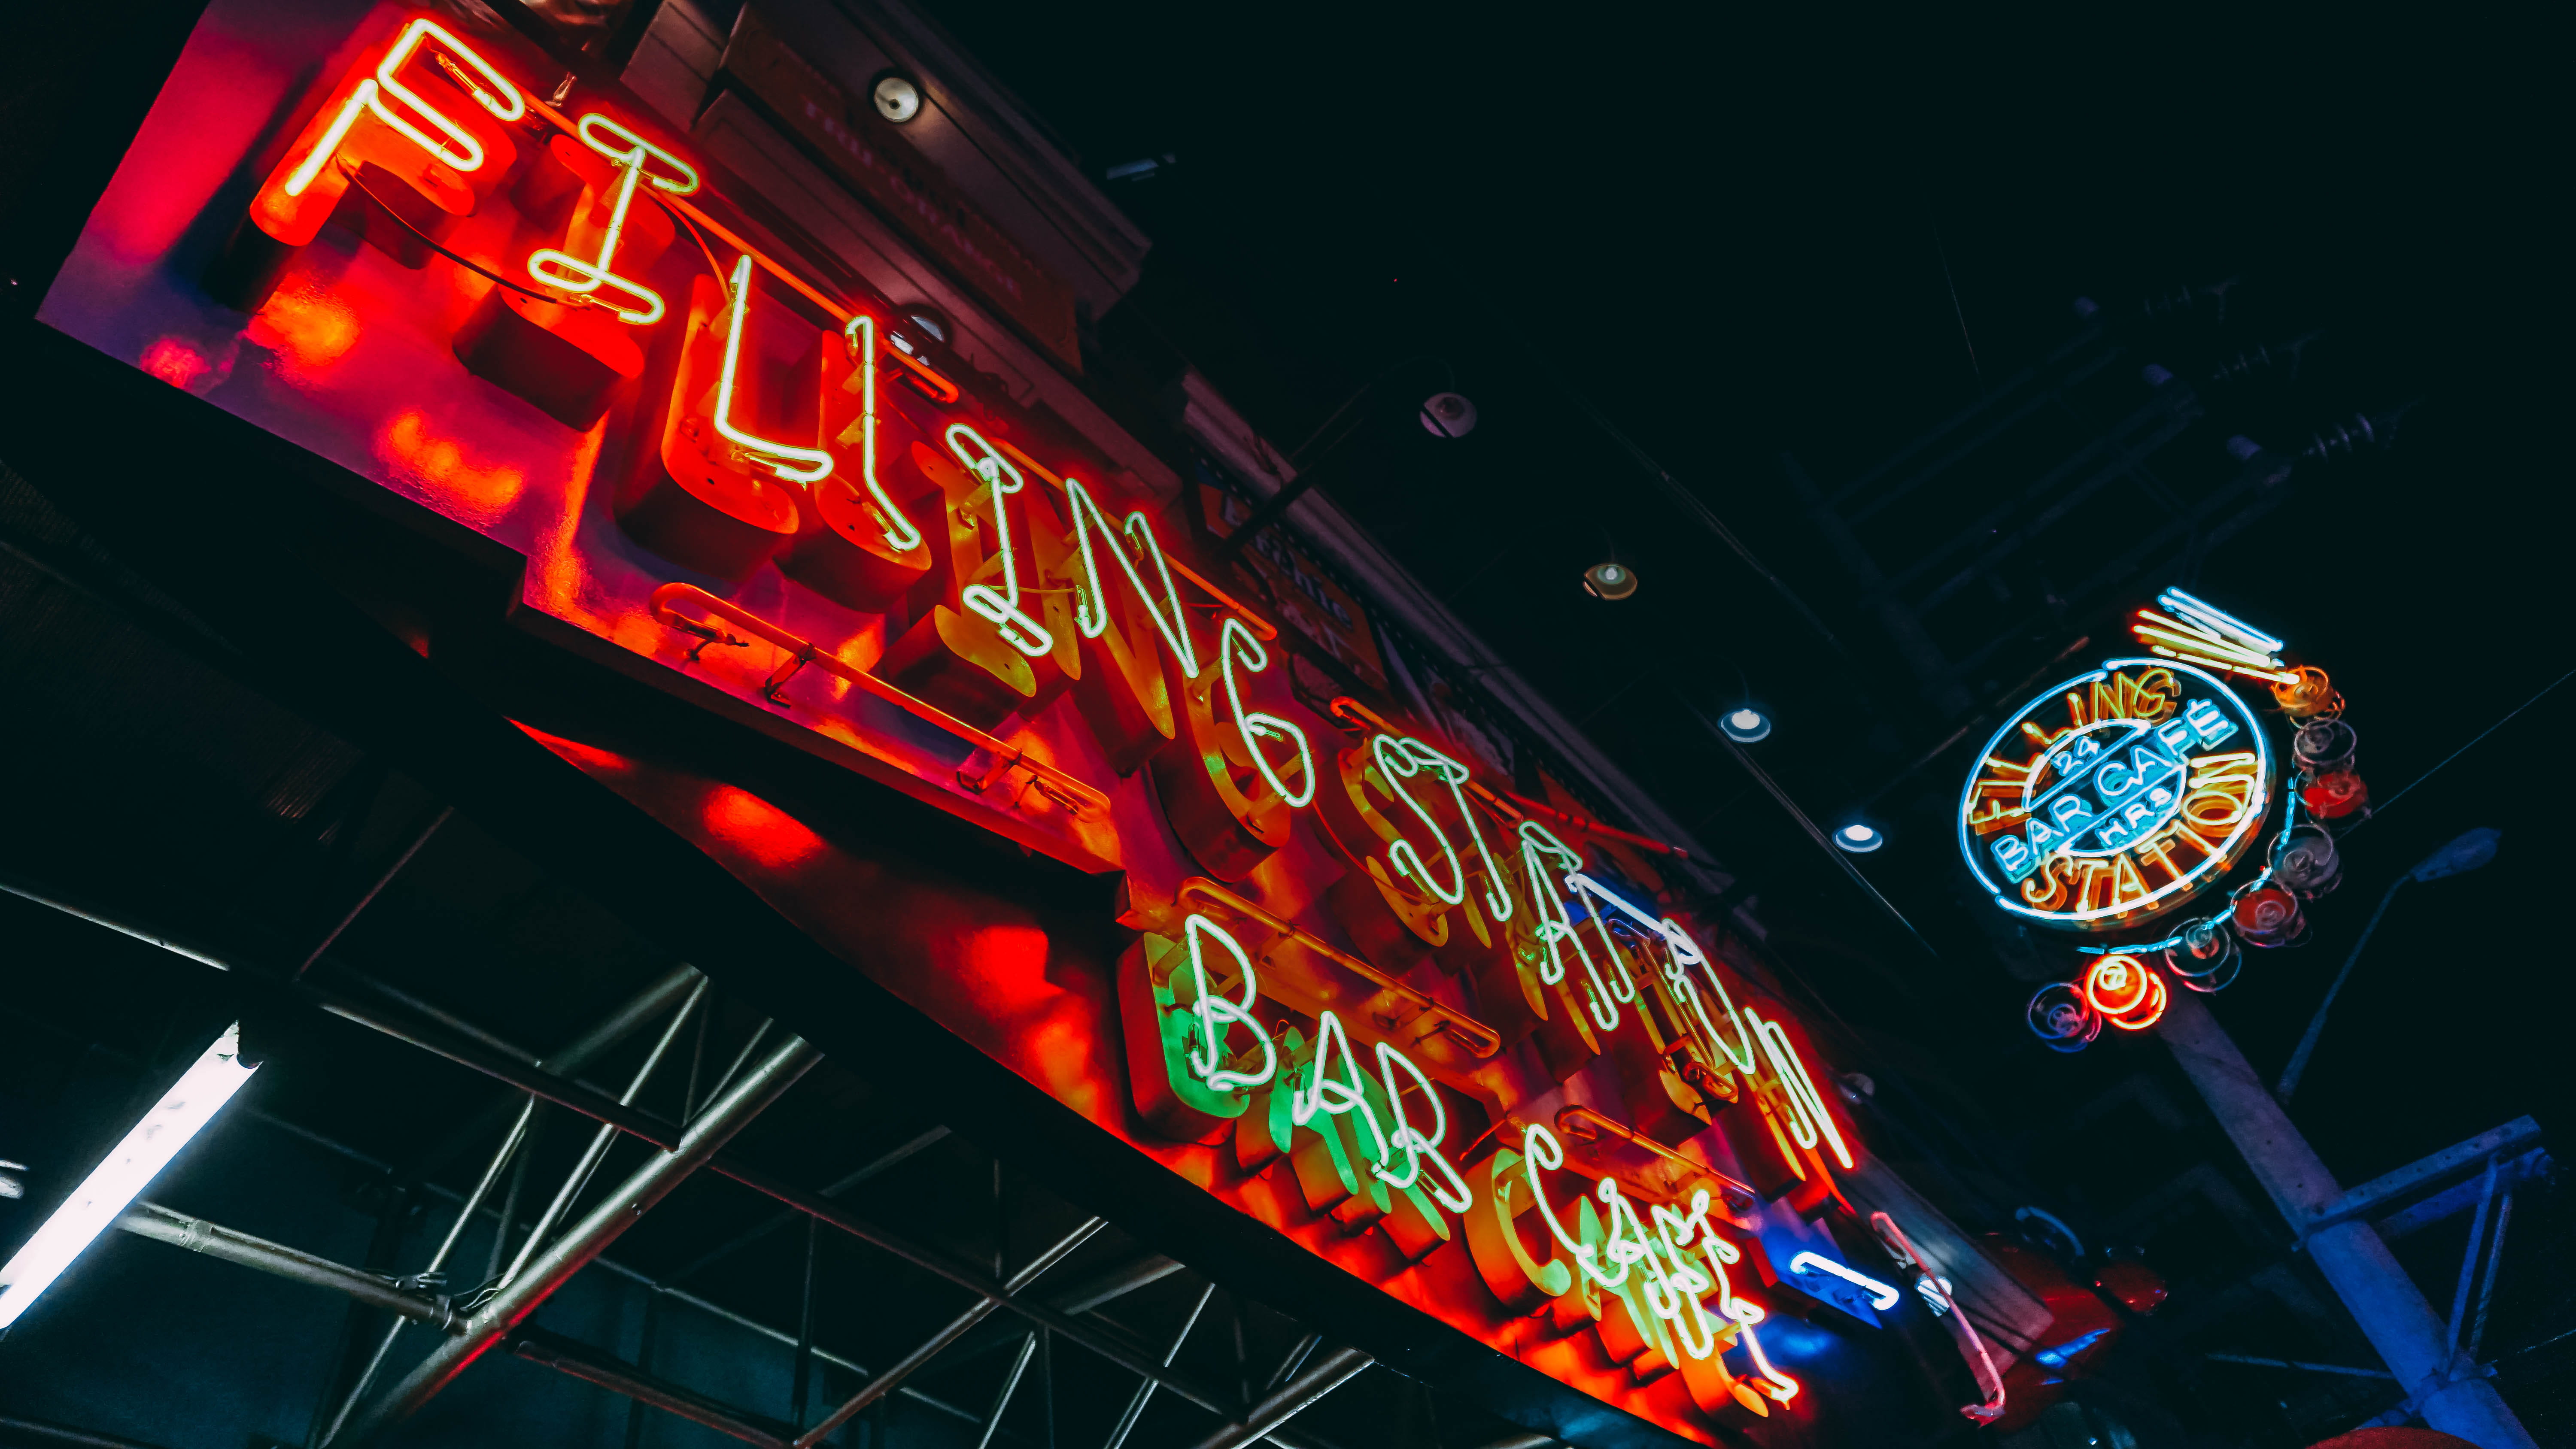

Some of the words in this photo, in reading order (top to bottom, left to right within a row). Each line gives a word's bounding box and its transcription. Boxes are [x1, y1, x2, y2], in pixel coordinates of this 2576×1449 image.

[258, 17, 1318, 815] FILLING
[1357, 732, 1855, 1170] STATION
[1968, 667, 2177, 831] FILLING
[2052, 736, 2101, 776] 24
[2094, 785, 2174, 847] HRS
[1990, 795, 2093, 882] BAR
[2021, 751, 2257, 914] STATION
[1176, 912, 1475, 1215] BAR
